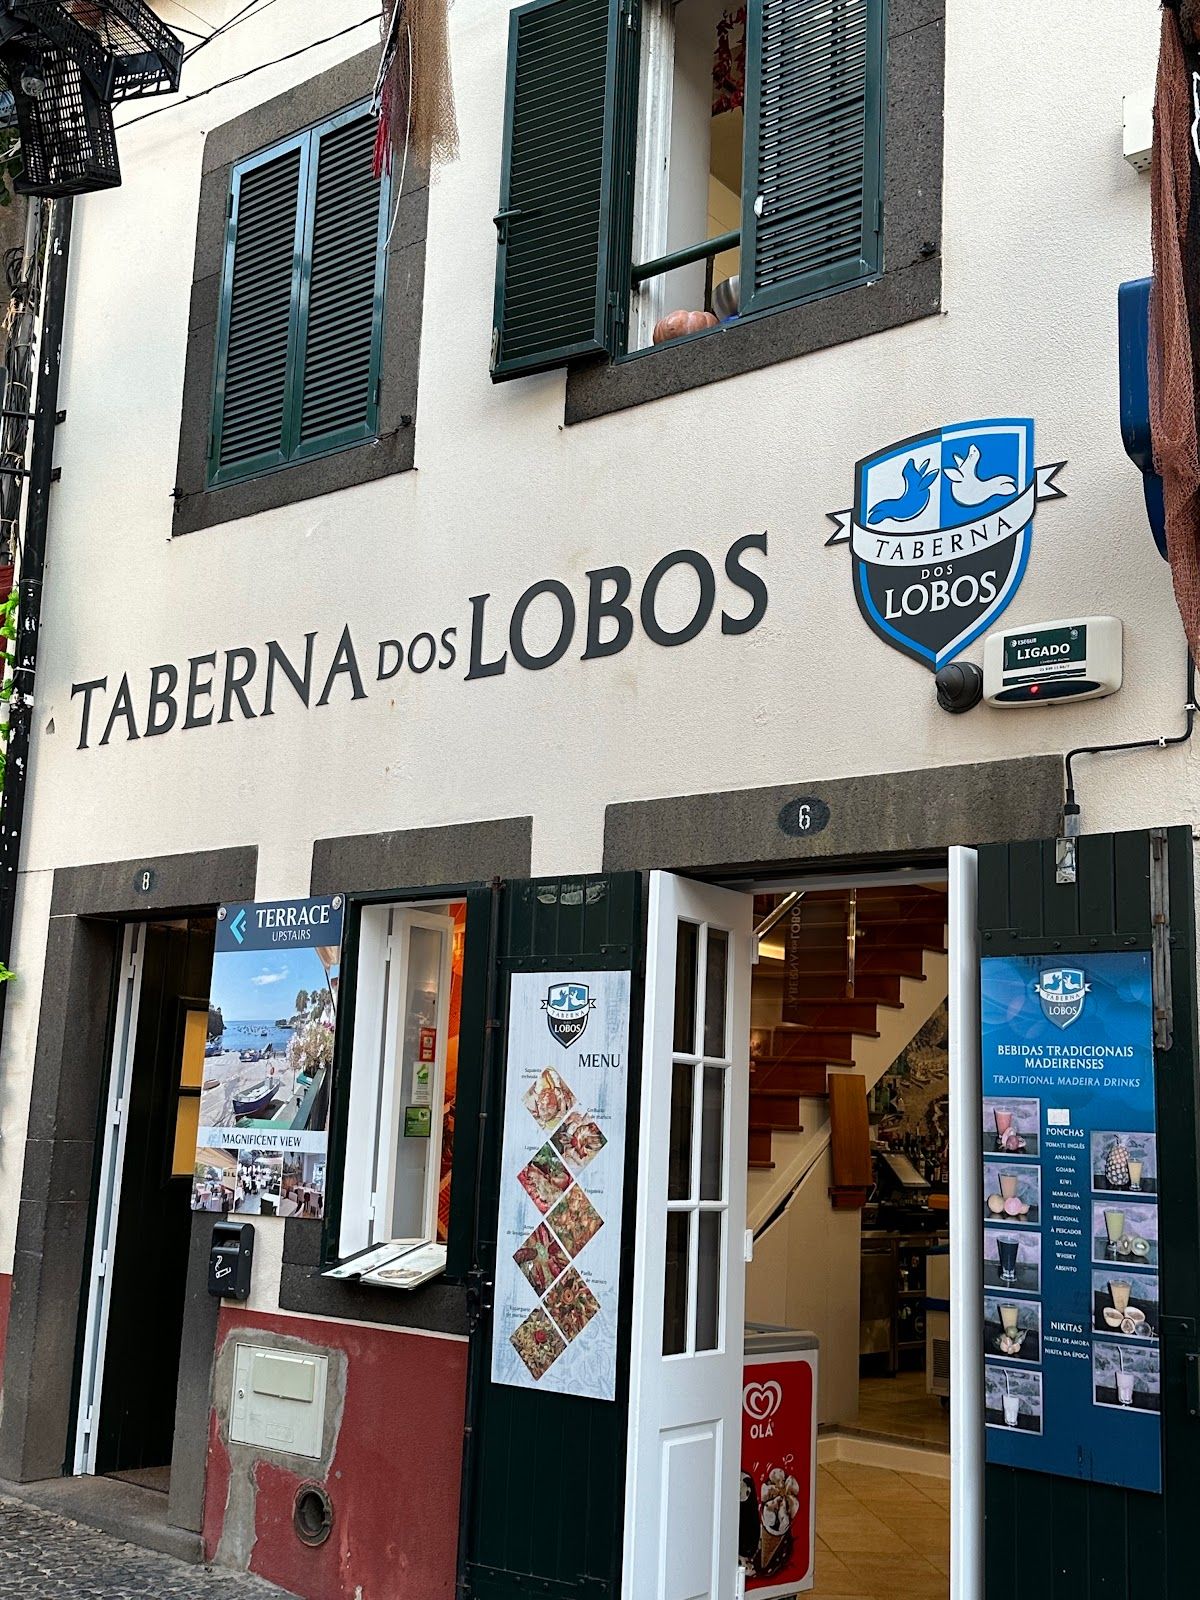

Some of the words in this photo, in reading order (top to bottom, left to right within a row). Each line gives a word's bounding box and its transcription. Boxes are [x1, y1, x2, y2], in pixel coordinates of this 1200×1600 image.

[876, 516, 1013, 560] TABERNA
[921, 564, 953, 580] DOS
[884, 571, 997, 620] LOBOS
[71, 623, 368, 749] TABERNA
[377, 627, 457, 681] DOS
[464, 531, 768, 681] LOBOS
[1017, 643, 1070, 660] LIGADO
[799, 804, 810, 830] 6
[142, 872, 150, 890] 8
[256, 904, 330, 928] TERRACE
[272, 929, 311, 942] UPSTAIRS
[1046, 994, 1080, 1002] TABERNA
[551, 1010, 585, 1019] TABERNA
[1049, 1006, 1077, 1015] LOBOS
[554, 1024, 581, 1033] LOBOS
[998, 1045, 1043, 1056] BEBIDAS
[1046, 1045, 1134, 1057] TRADICIONAIS
[578, 1053, 621, 1068] MENU
[1025, 1058, 1104, 1070] MADEIRENSES
[993, 1075, 1054, 1085] TRADITIONAL
[1057, 1077, 1100, 1086] MADEIRA
[1103, 1078, 1141, 1088] DRINKS
[1046, 1128, 1084, 1137] PONCHAS
[222, 1133, 278, 1146] MAGNIFICENT
[280, 1136, 302, 1147] VIEW
[1051, 1202, 1081, 1210] TANGERINA
[1053, 1215, 1079, 1223] REGIONAL
[1055, 1265, 1078, 1273] ABSINTO
[1050, 1321, 1083, 1334] NIKITAS
[1043, 1335, 1061, 1343] NIKITA
[1070, 1339, 1090, 1347] AMORA
[1044, 1348, 1063, 1356] NIKITA
[750, 1419, 773, 1439] OLÁ
